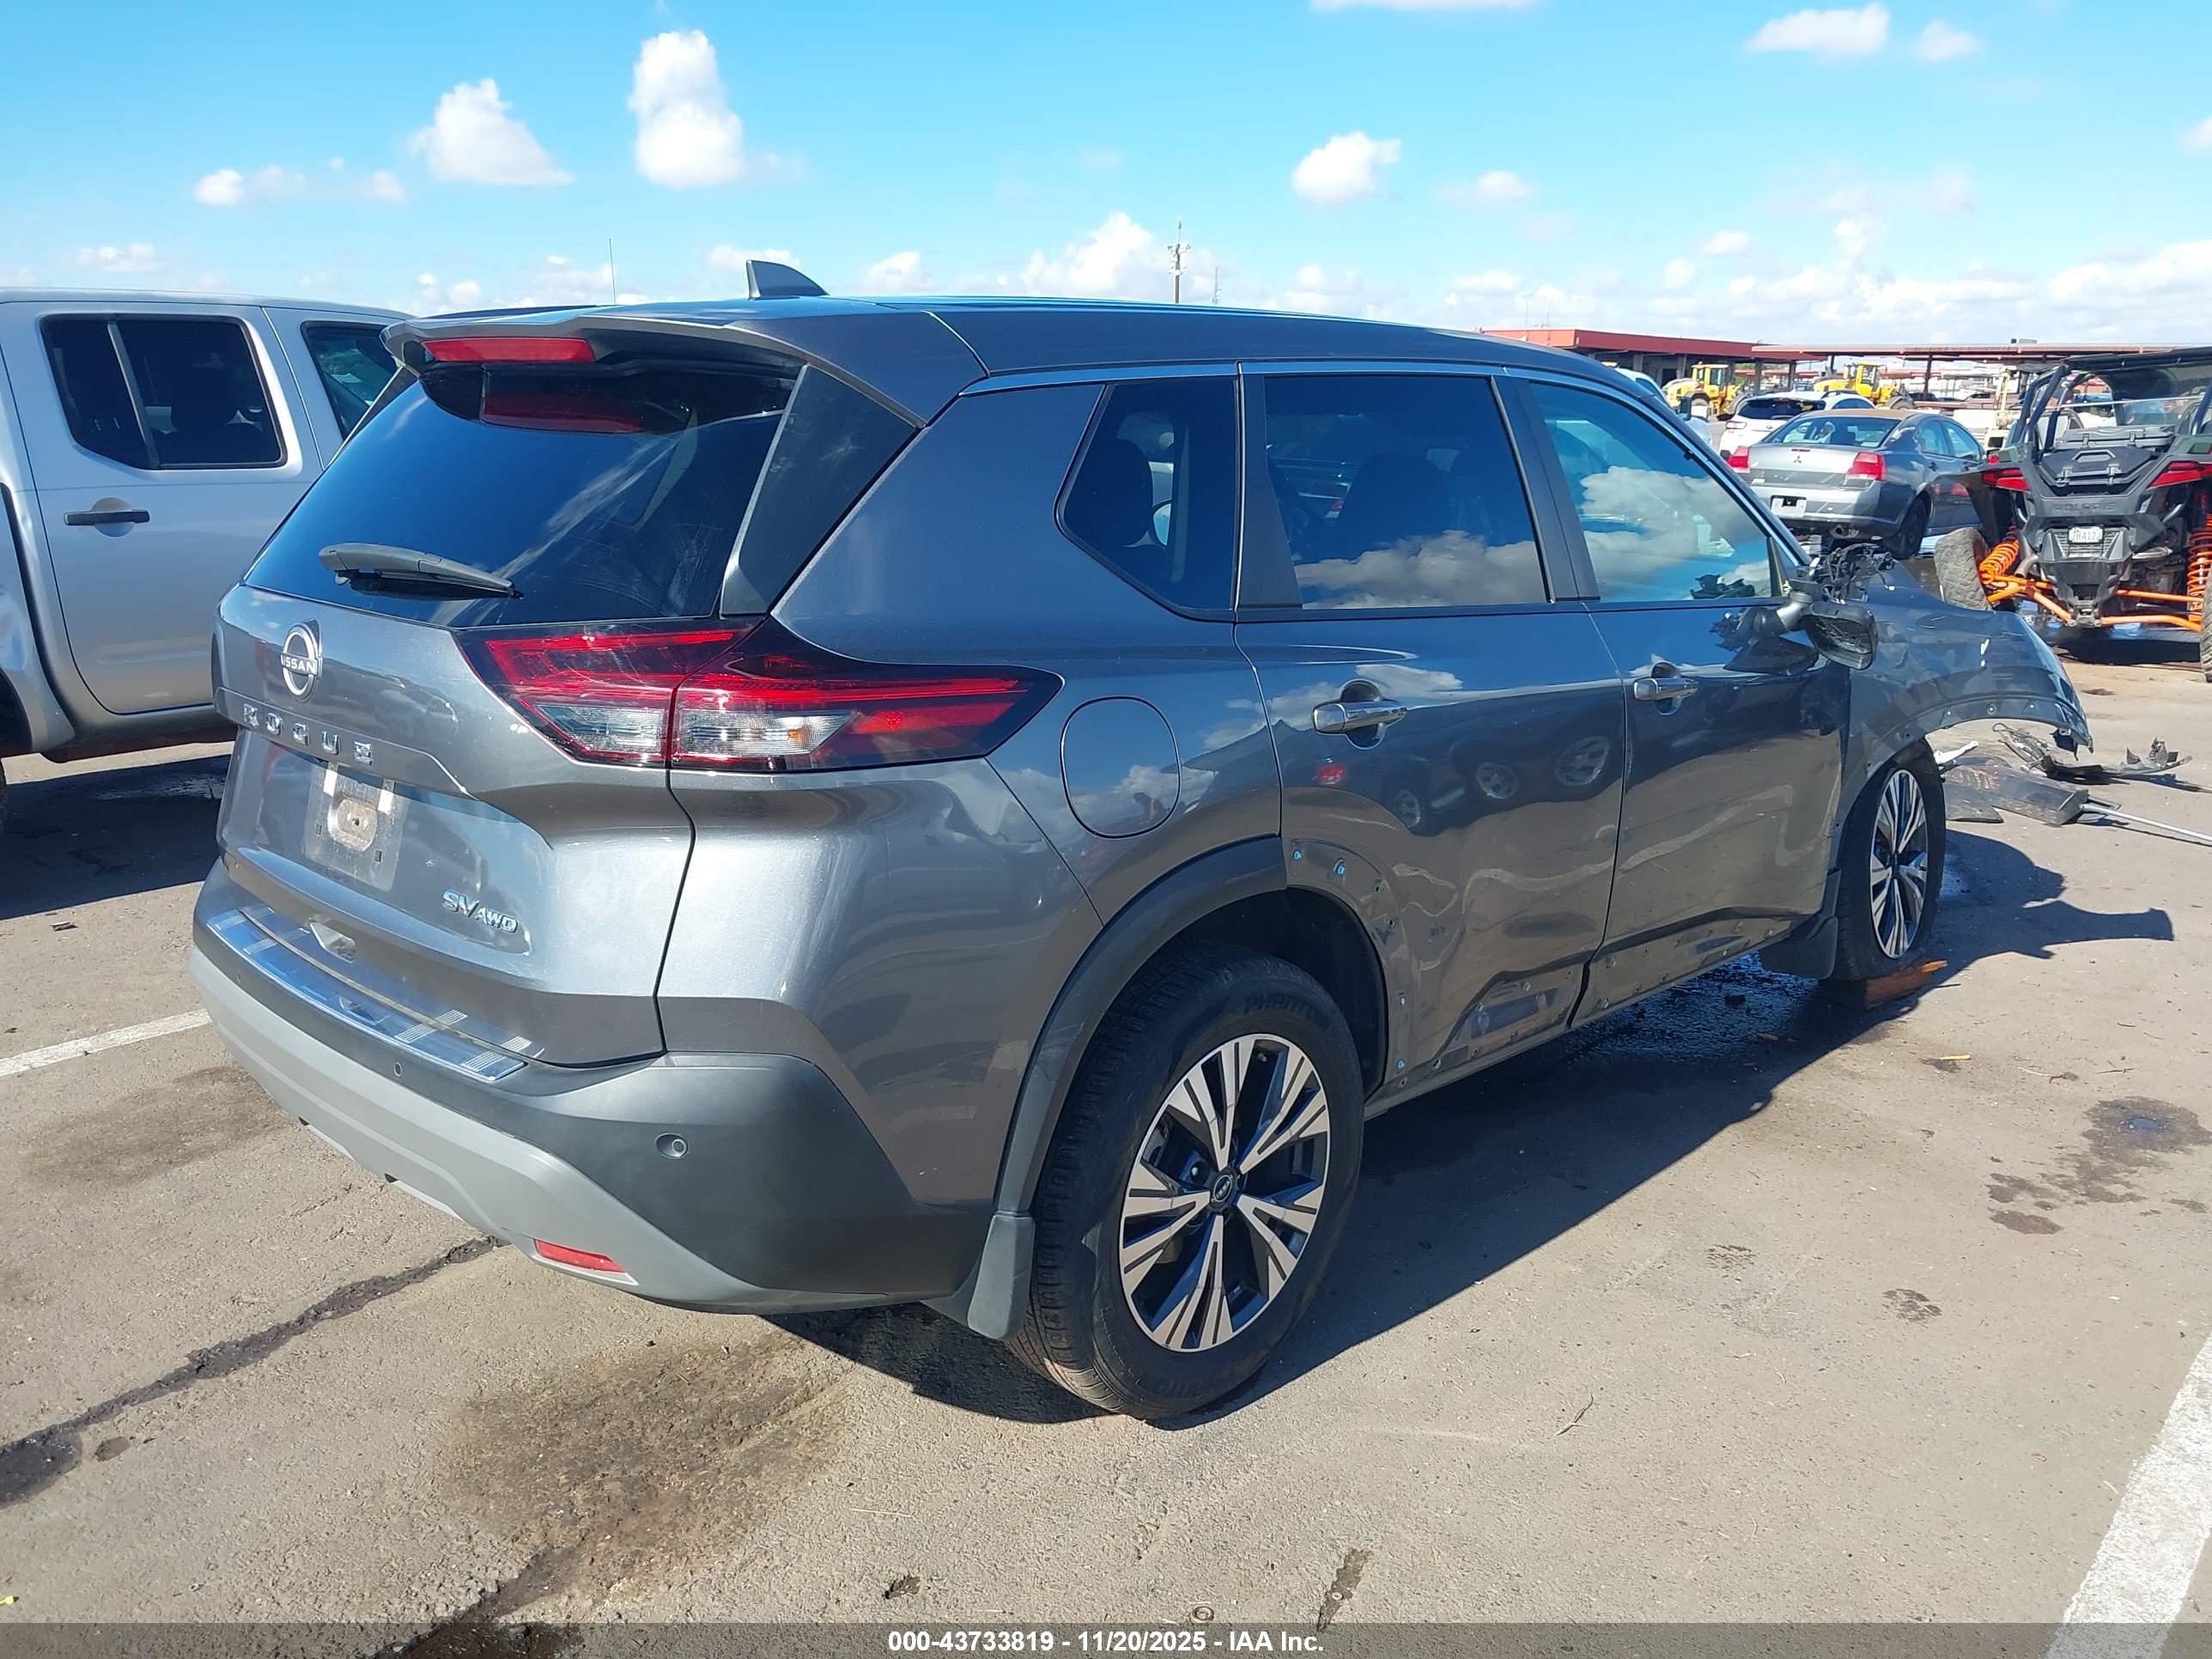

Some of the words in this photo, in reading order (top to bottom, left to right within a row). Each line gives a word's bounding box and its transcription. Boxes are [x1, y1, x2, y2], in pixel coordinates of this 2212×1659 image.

[280, 654, 318, 675] NISSAN
[244, 703, 373, 766] ROGUE
[441, 889, 481, 915] SV
[474, 907, 518, 933] AWD
